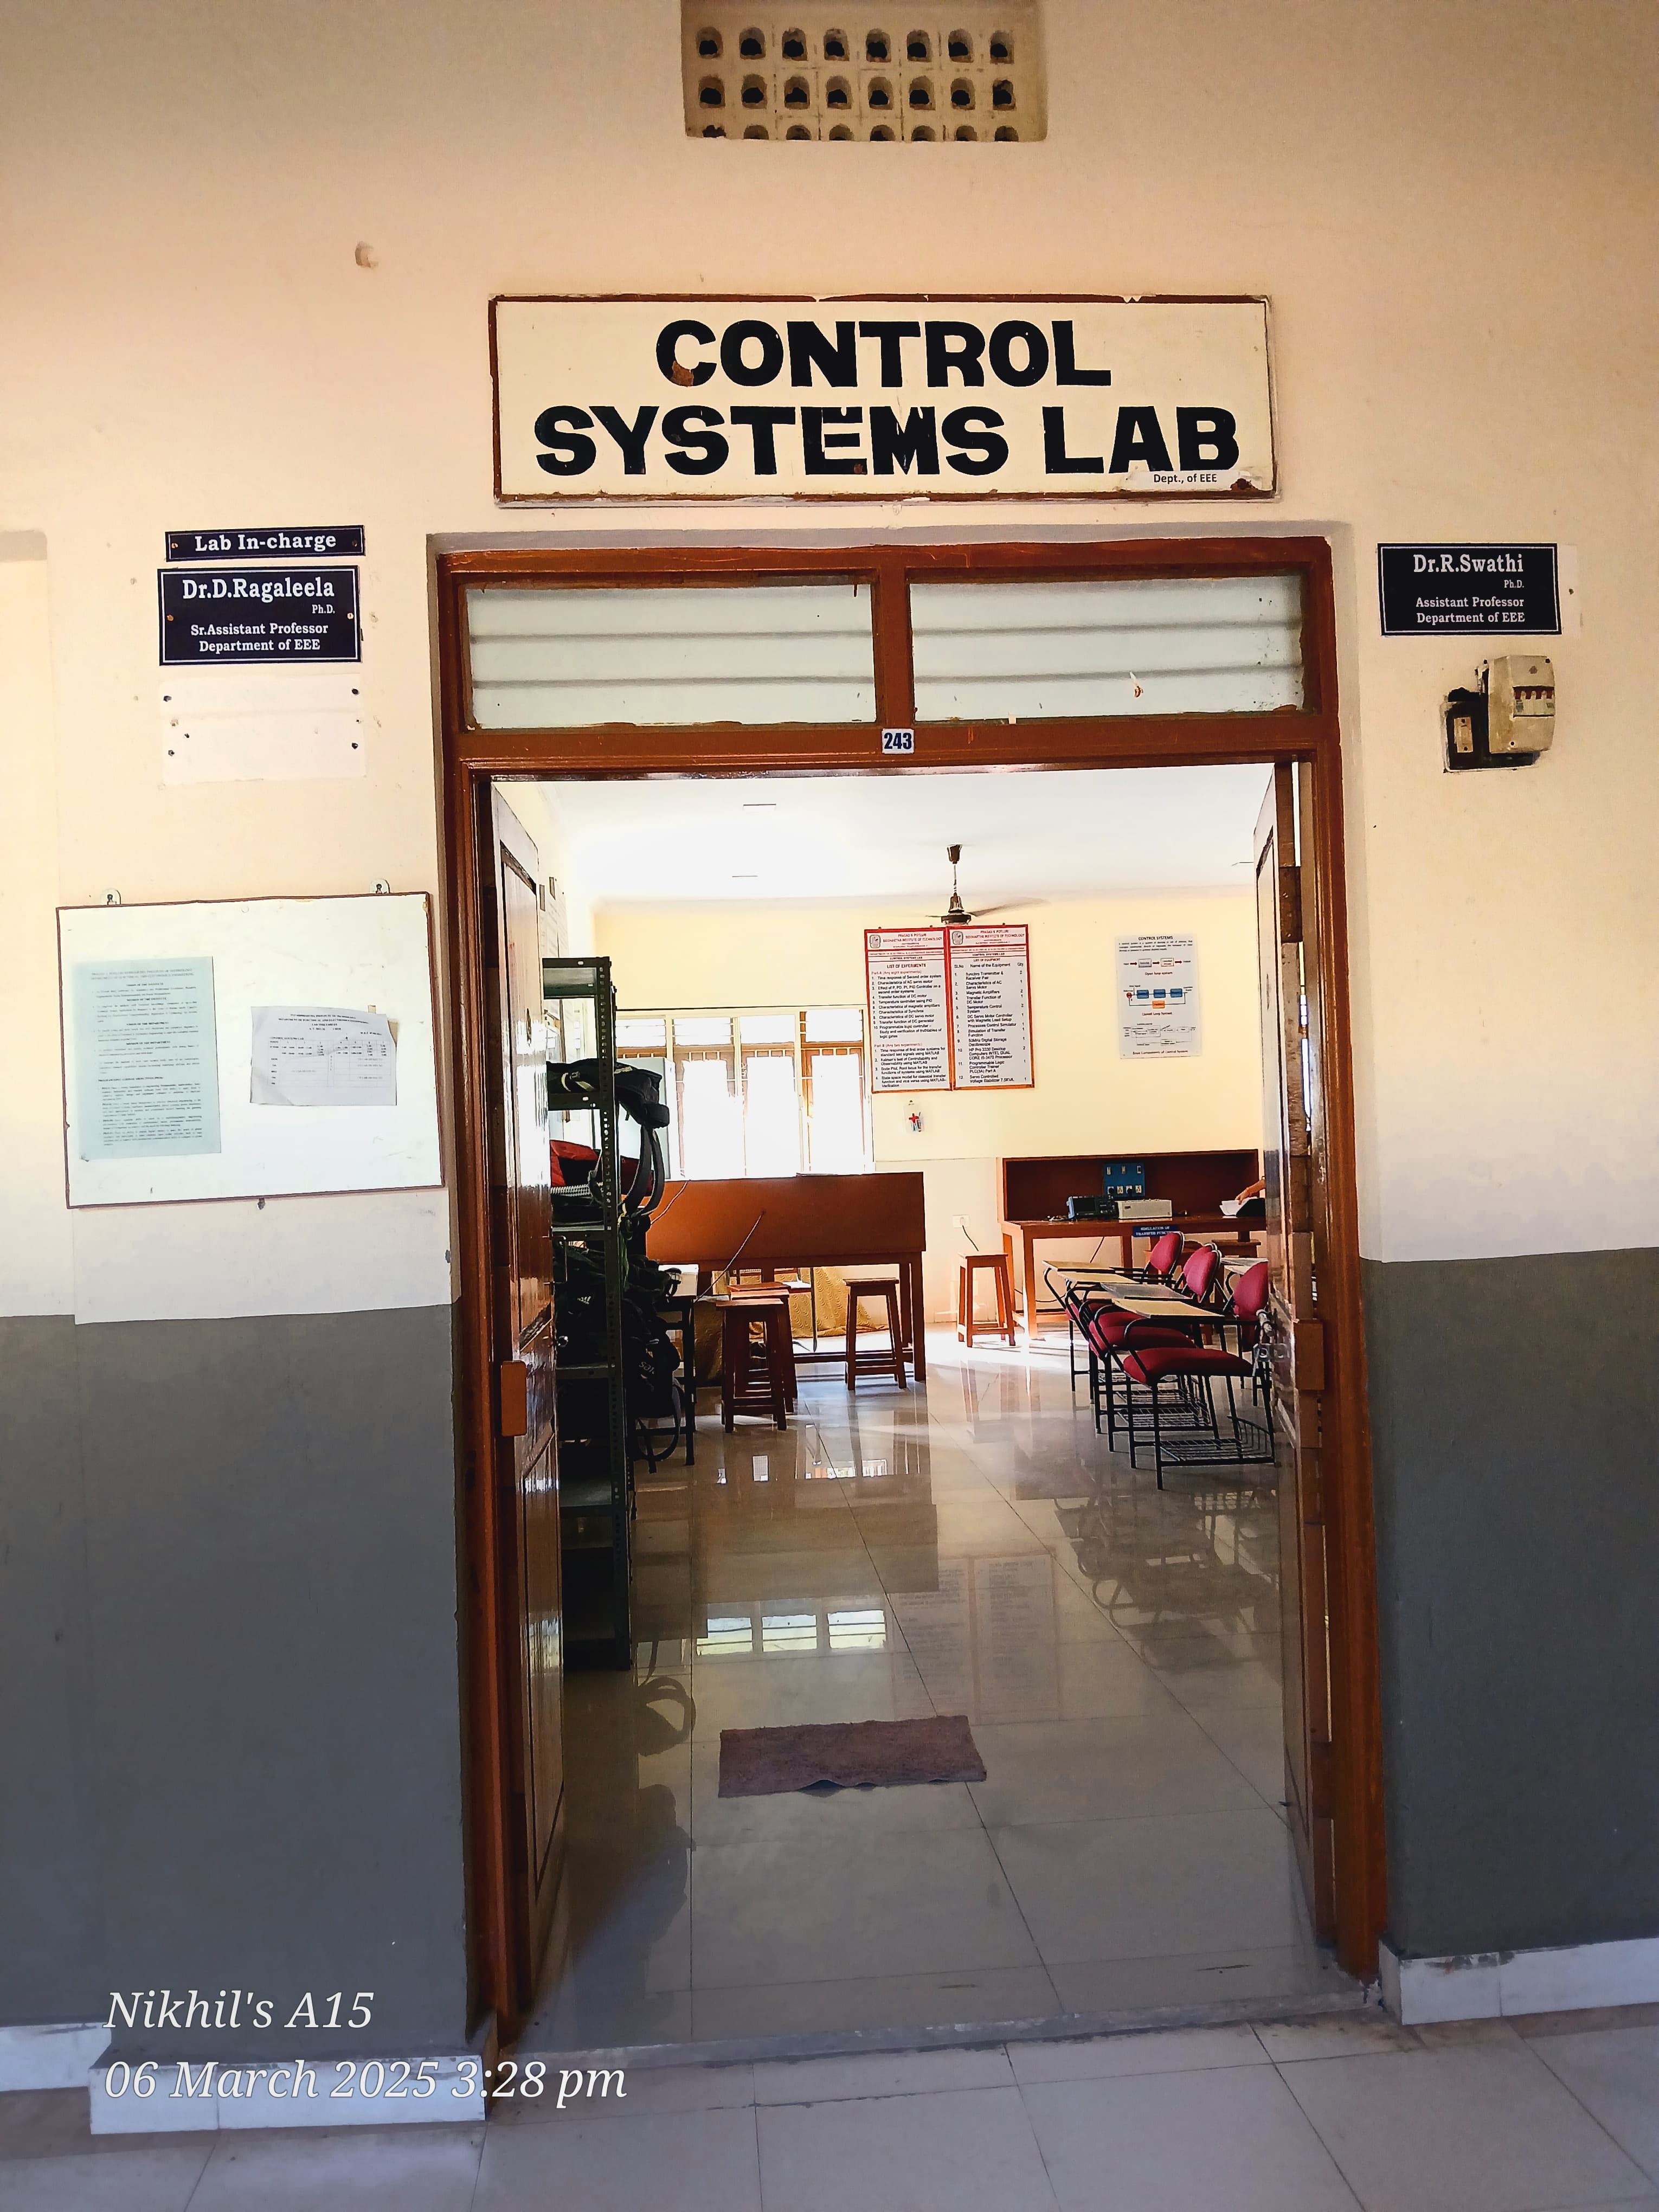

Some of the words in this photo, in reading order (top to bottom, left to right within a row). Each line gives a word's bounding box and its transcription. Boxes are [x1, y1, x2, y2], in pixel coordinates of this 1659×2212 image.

[655, 319, 1111, 388] CONTROL
[534, 404, 1010, 476] SYSTEMS
[1043, 404, 1240, 473] LAB
[1154, 474, 1184, 484] Dept.,
[1187, 474, 1197, 483] of
[1200, 474, 1217, 482] EEE
[195, 535, 232, 551] Lab
[238, 533, 337, 551] In-charge
[1413, 554, 1523, 573] Dr.R.Swathi
[182, 577, 335, 603] Dr.D.Ragaleela
[1504, 580, 1525, 588] Ph.D.
[312, 605, 335, 614] Ph.D.
[1416, 597, 1469, 607] Assistant
[1472, 597, 1525, 607] Professor
[1417, 613, 1484, 625] Department
[1488, 612, 1499, 622] of
[1502, 612, 1525, 622] EEE
[191, 623, 266, 635] Sr.Assistant
[269, 623, 329, 634] Professor
[200, 639, 274, 654] Department
[278, 639, 292, 650] of
[294, 639, 320, 650] EEE
[884, 732, 912, 749] 243
